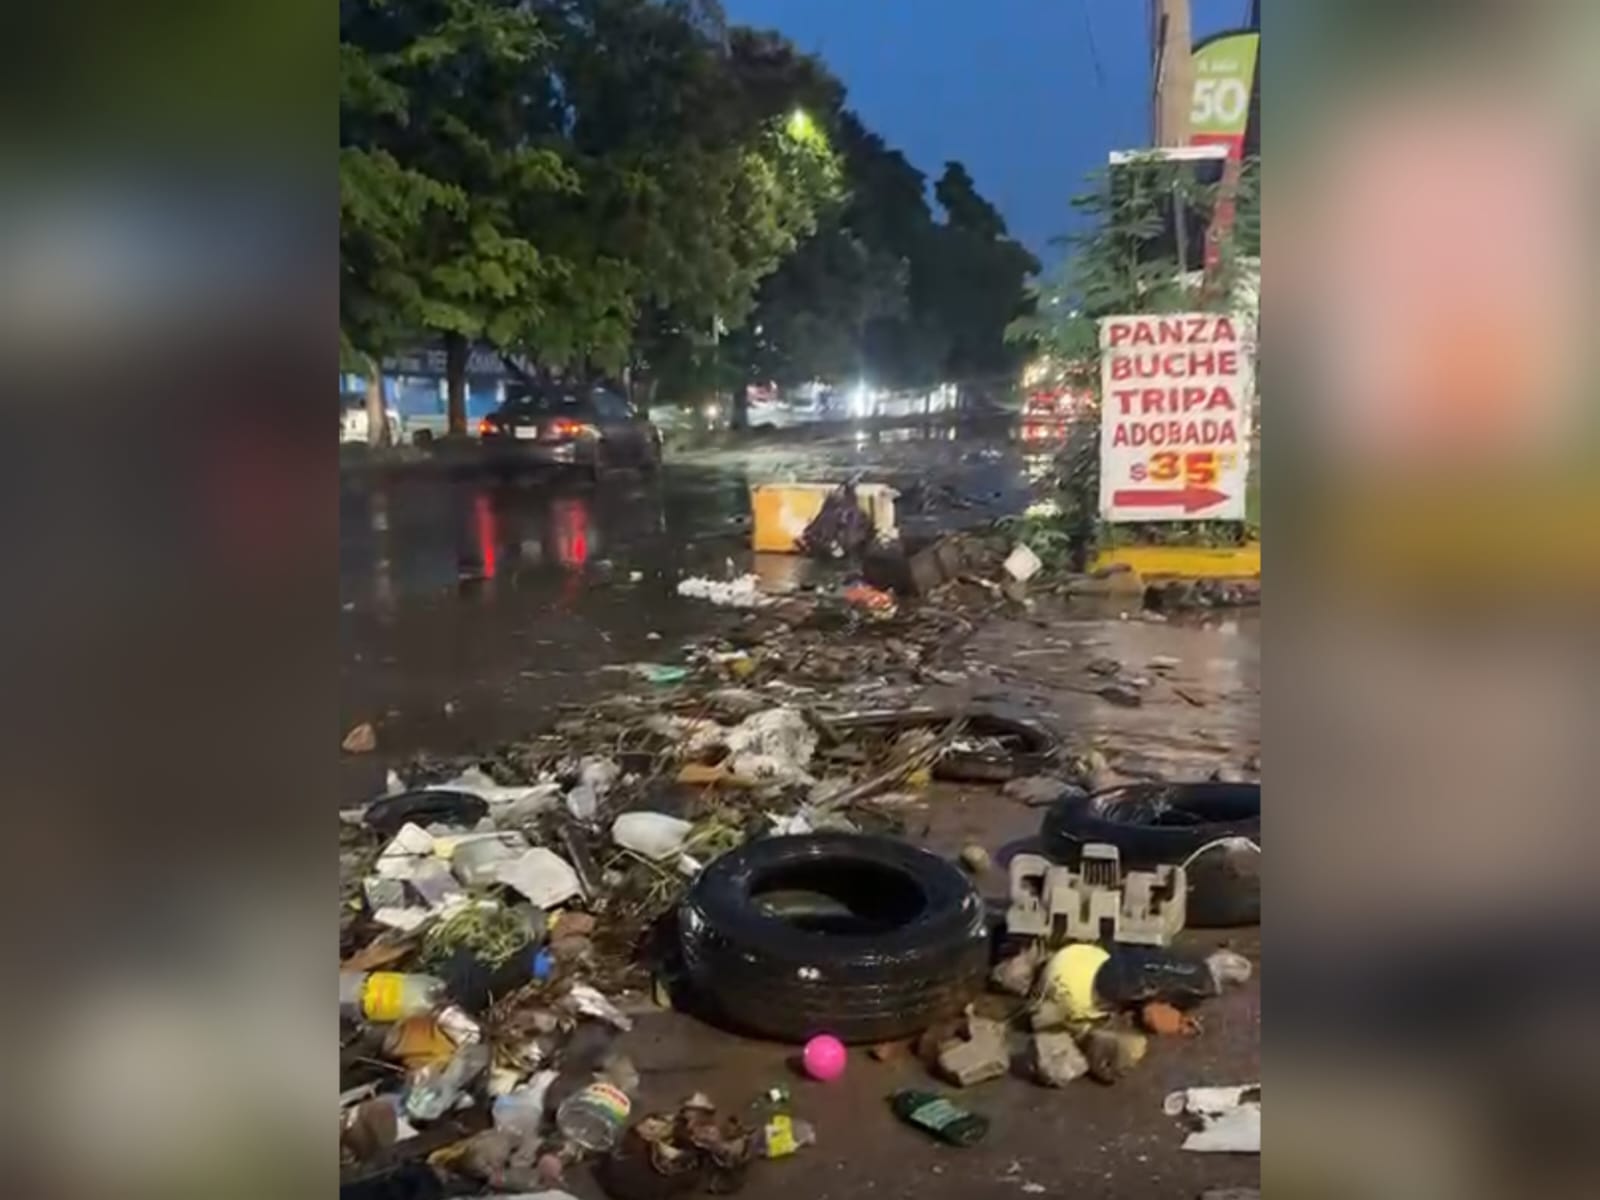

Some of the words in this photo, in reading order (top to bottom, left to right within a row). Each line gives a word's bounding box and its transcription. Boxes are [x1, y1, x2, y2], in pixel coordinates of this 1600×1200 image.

[1190, 79, 1247, 123] 50
[1109, 318, 1236, 347] PANZA
[1111, 351, 1238, 381] BUCHE
[1113, 387, 1235, 415] TRIPA
[1113, 420, 1237, 447] ADOBADA
